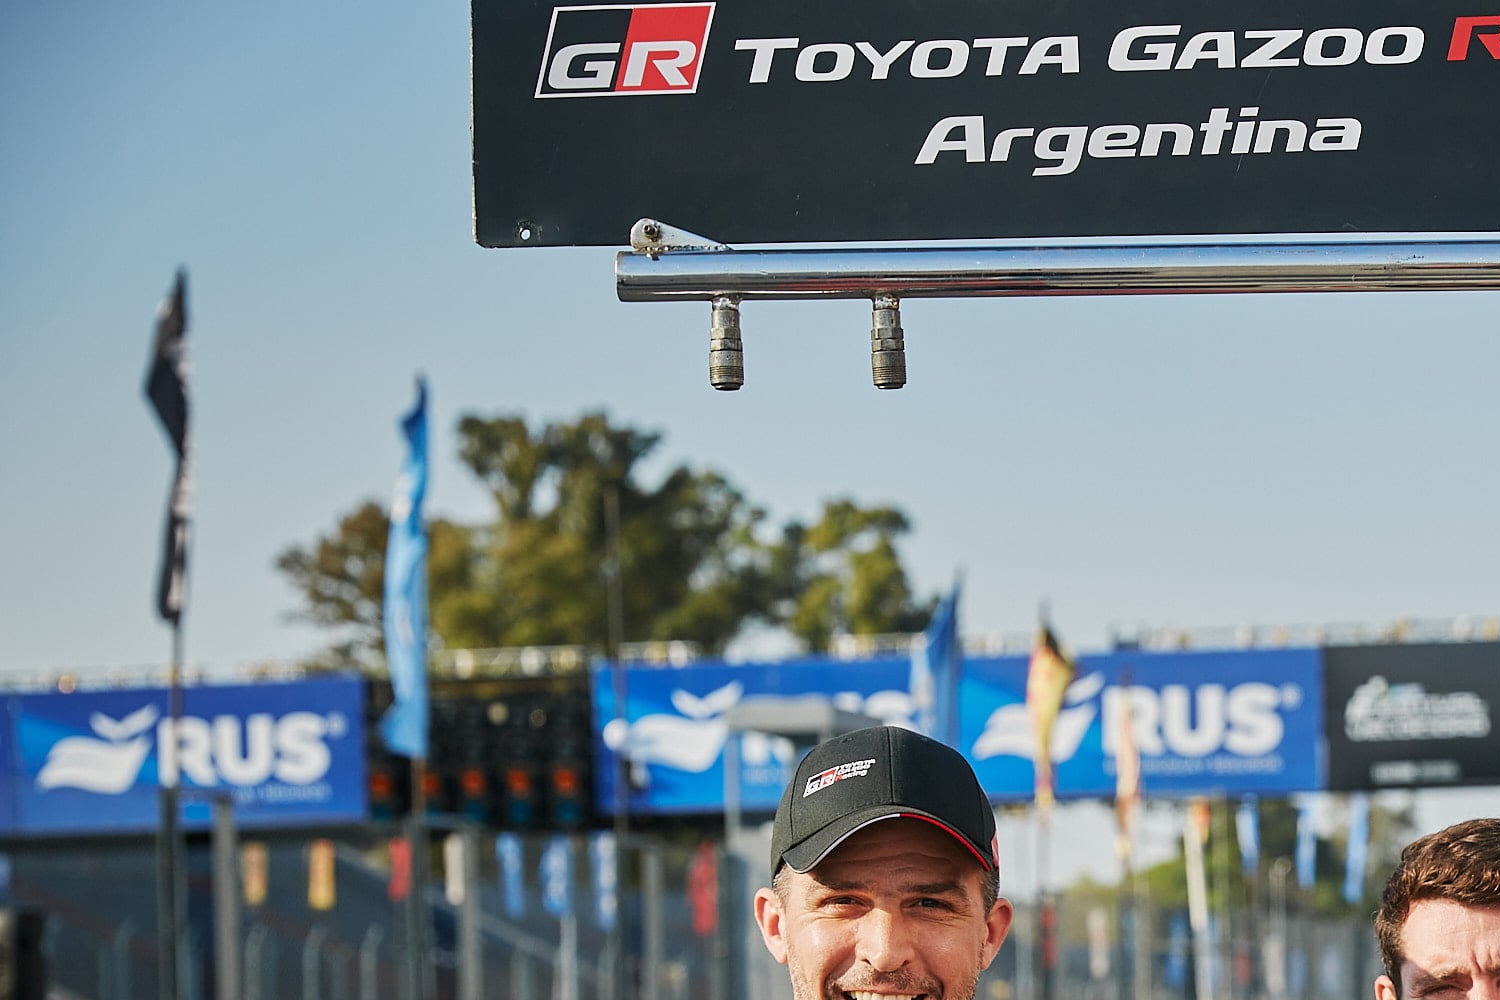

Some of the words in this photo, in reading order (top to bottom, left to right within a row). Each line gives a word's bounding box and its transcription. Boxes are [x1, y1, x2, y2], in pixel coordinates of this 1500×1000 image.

[547, 39, 699, 90] GR
[733, 36, 1080, 84] TOYOTA
[1107, 24, 1426, 72] GAZOO
[914, 106, 1362, 177] Argentina
